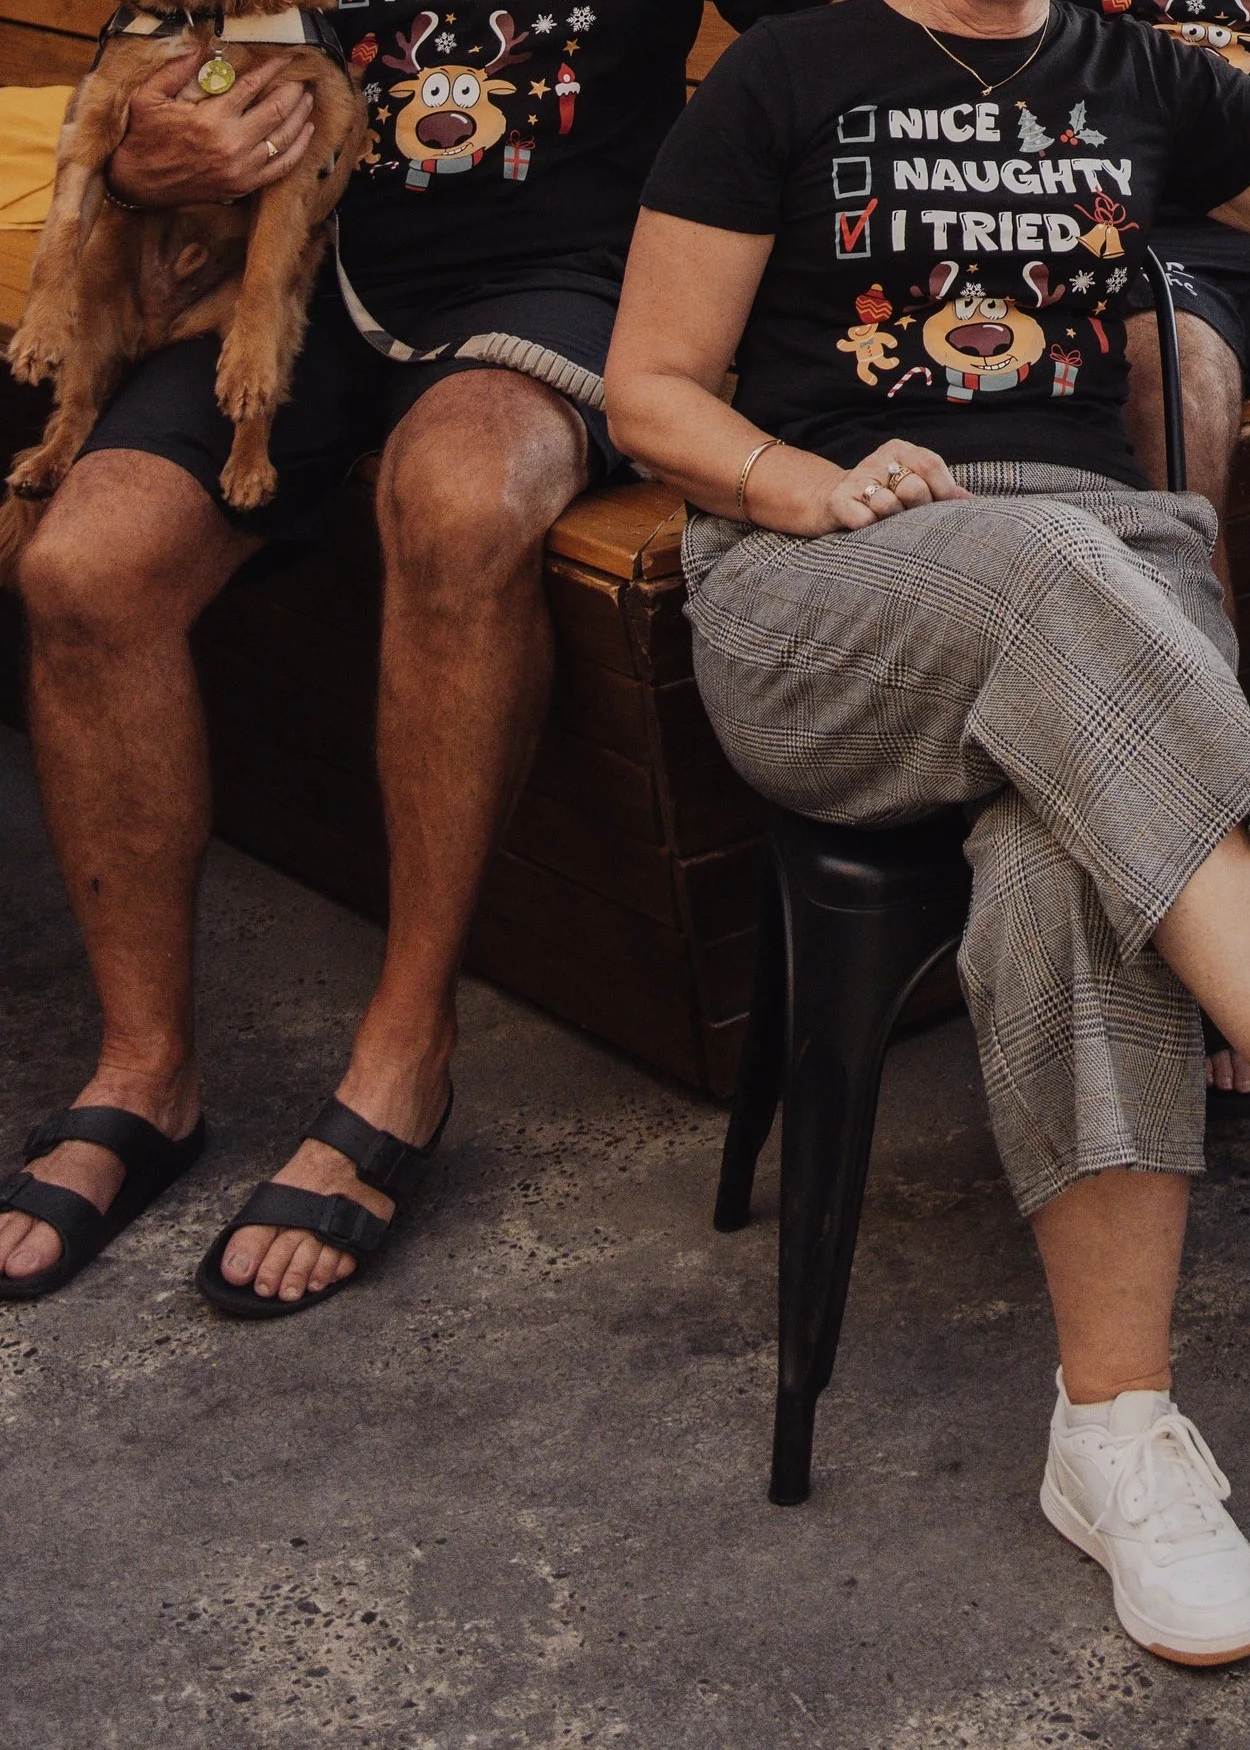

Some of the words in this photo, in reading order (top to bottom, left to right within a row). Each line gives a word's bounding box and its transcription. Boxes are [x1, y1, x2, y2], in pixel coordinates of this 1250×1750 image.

[888, 103, 1001, 143] NICE
[893, 157, 1132, 196] NAUGHTY
[892, 209, 907, 251] I
[921, 210, 1081, 252] TRIED
